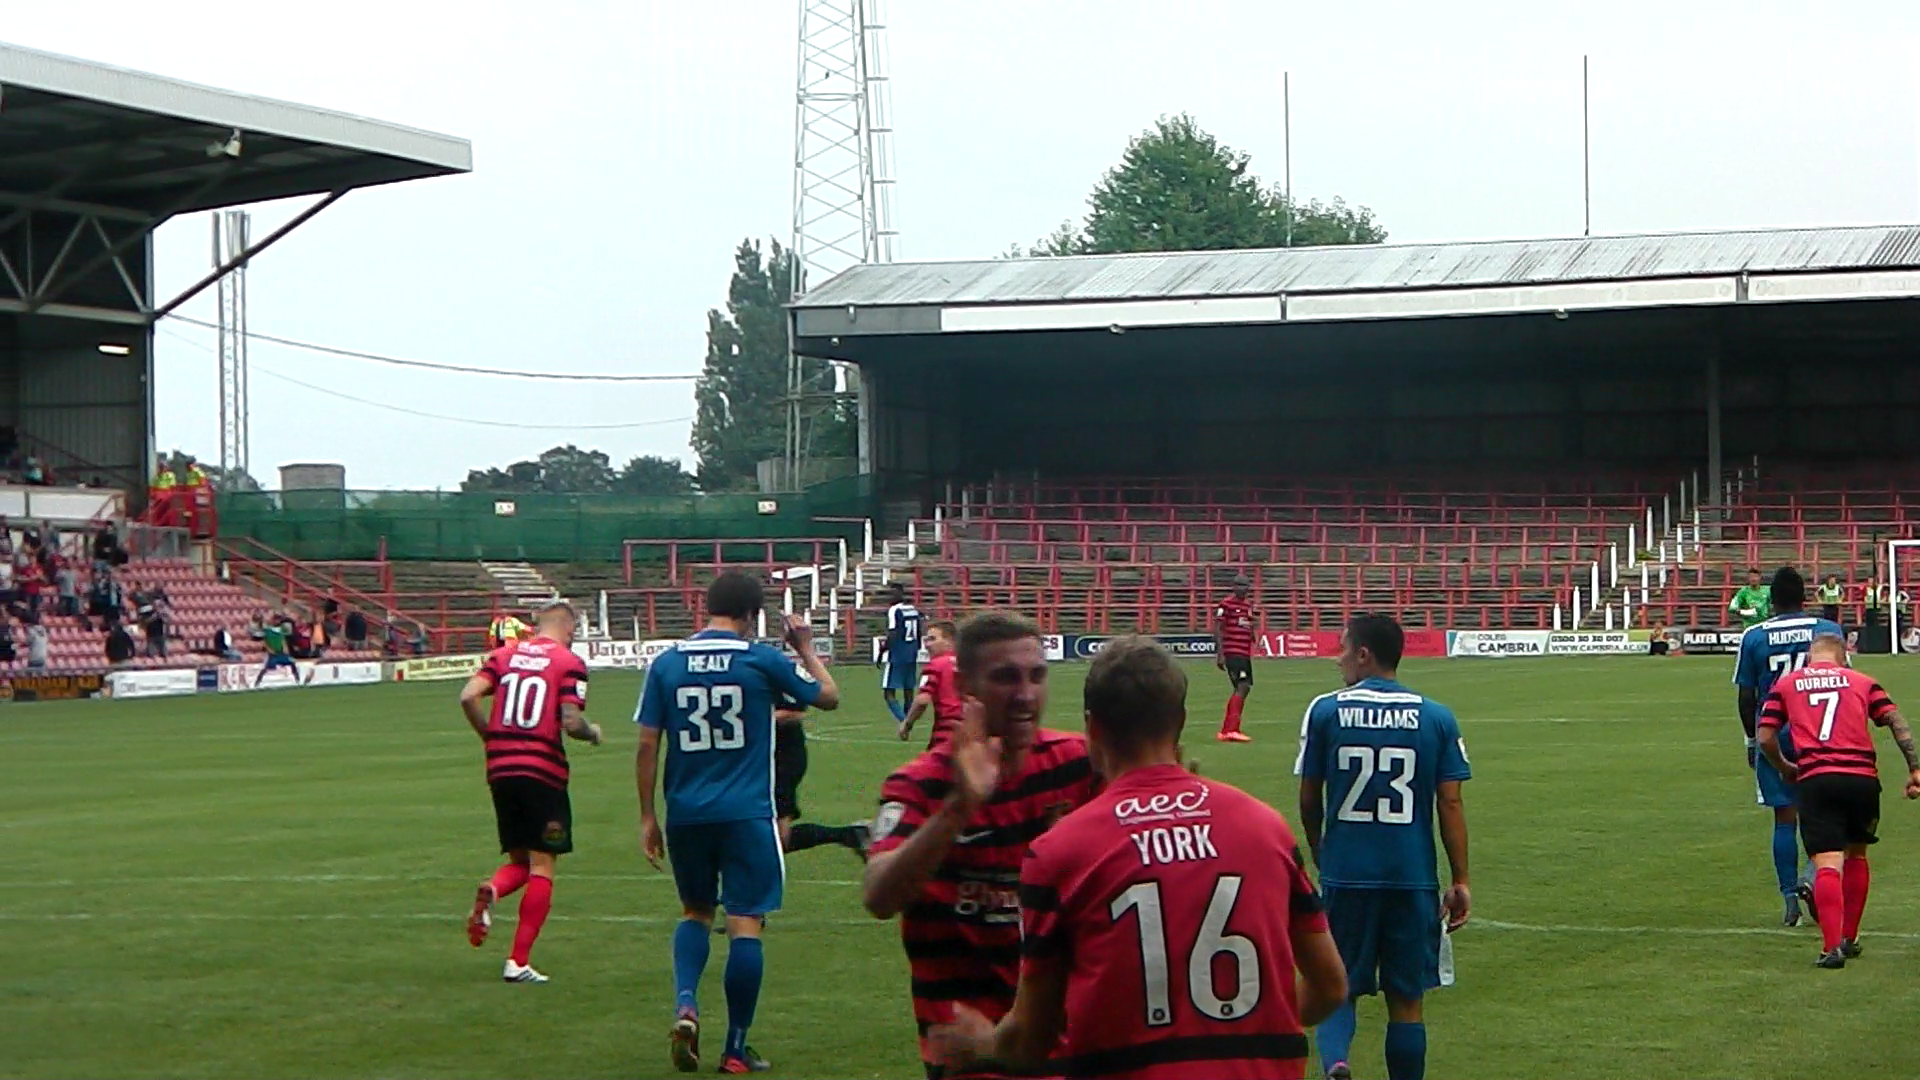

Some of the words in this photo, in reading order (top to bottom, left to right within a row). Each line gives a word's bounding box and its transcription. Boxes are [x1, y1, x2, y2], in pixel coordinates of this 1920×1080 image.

[1254, 634, 1287, 657] A1
[1477, 642, 1540, 653] CAMBRIA
[1683, 633, 1718, 644] PLAYER
[1720, 633, 1743, 644] SPO
[1769, 629, 1813, 646] HUDSON
[688, 654, 733, 673] HEALY
[1795, 675, 1850, 692] DURRELL
[500, 672, 547, 728] 10
[676, 684, 746, 752] 33
[1338, 707, 1420, 729] WILLIAMS
[1809, 691, 1840, 741] 7
[1337, 746, 1417, 823] 23
[1131, 824, 1219, 866] YORK
[1110, 875, 1260, 1026] 16
